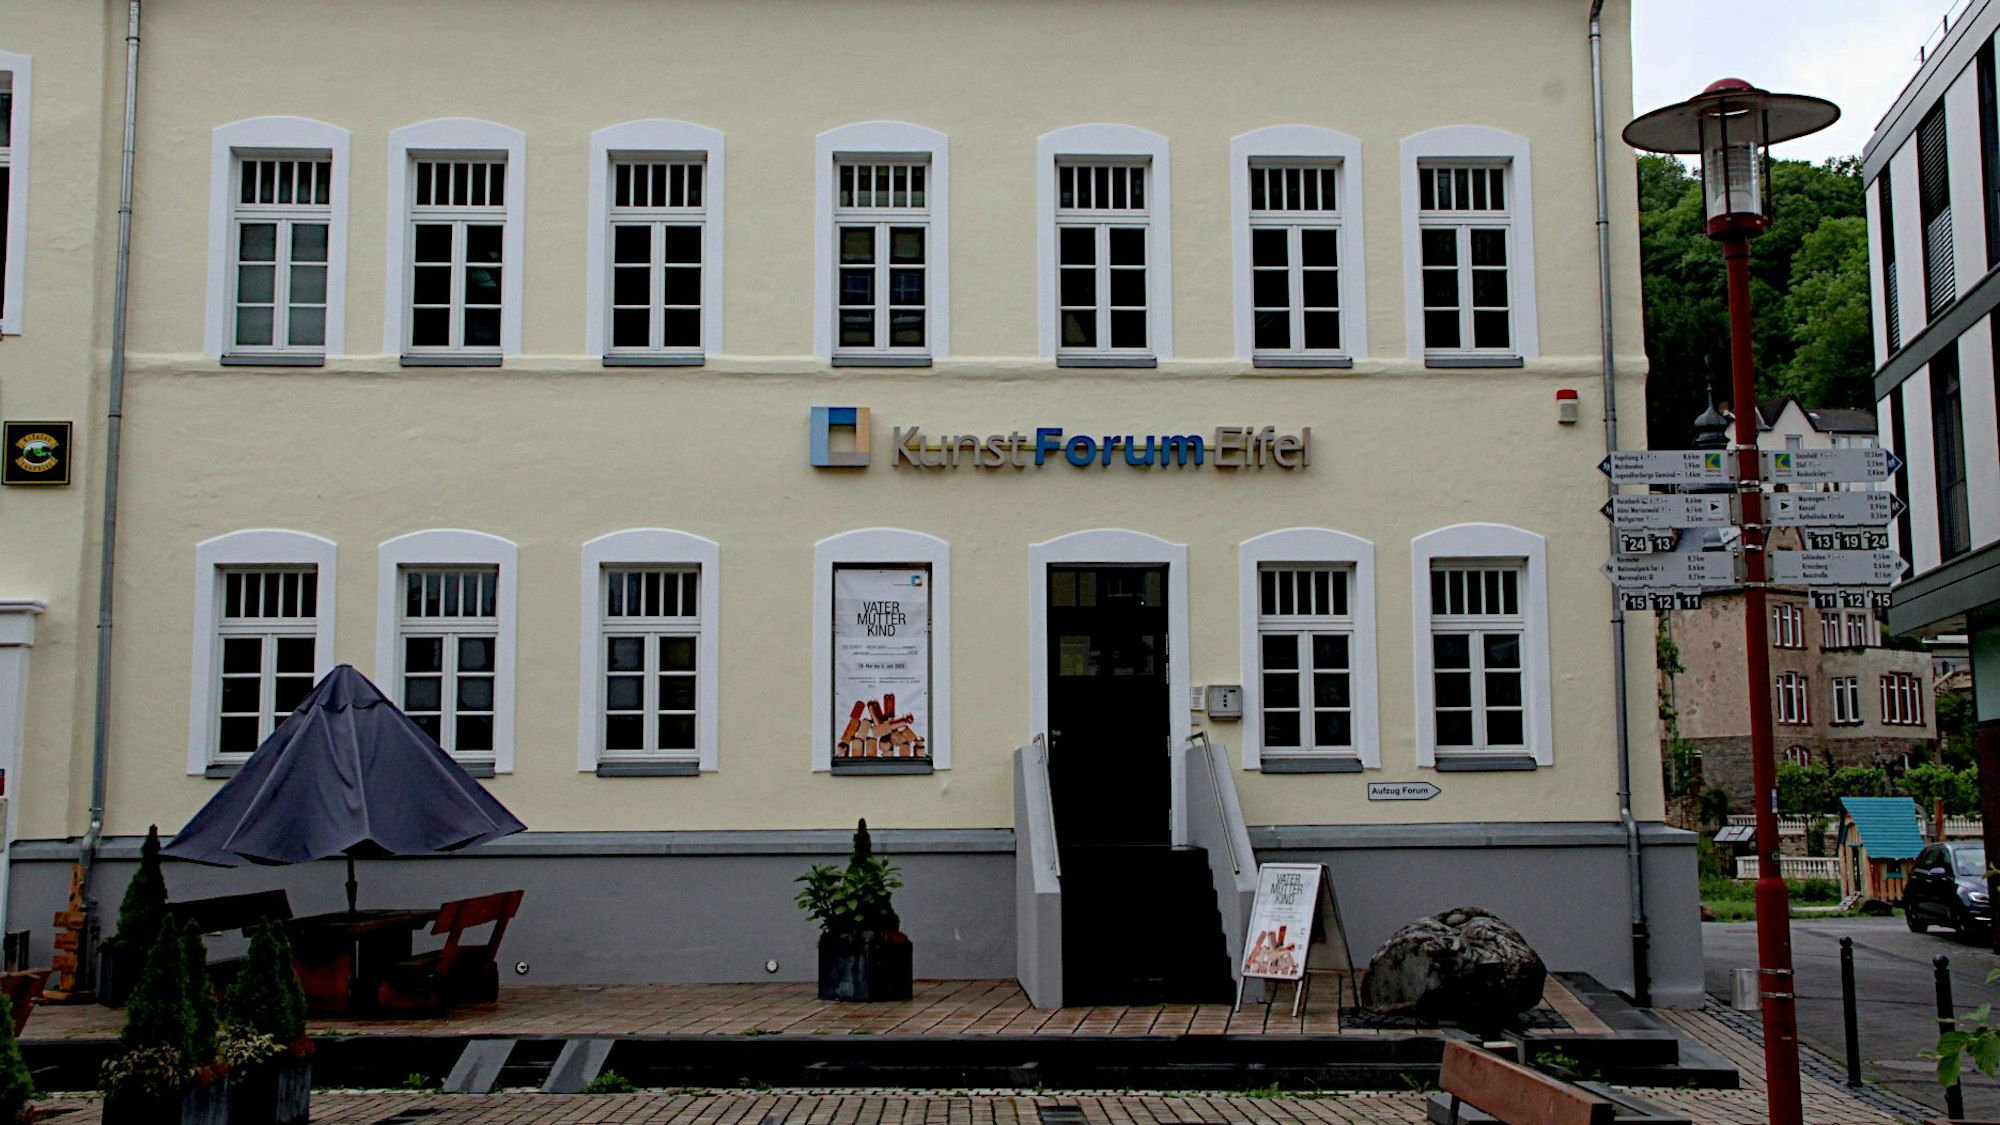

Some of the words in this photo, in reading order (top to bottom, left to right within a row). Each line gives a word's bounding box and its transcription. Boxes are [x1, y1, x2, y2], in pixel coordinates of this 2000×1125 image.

[1629, 538, 1645, 551] 24
[1656, 538, 1671, 550] 13
[1816, 536, 1831, 548] 13
[1844, 536, 1858, 548] 19
[1871, 535, 1887, 547] 24
[1630, 597, 1645, 609] 15
[1657, 596, 1672, 609] 12
[1684, 596, 1699, 608] 11
[1820, 595, 1833, 607] 11
[1848, 595, 1862, 607] 12
[1876, 594, 1891, 607] 15
[863, 601, 900, 614] VATER
[857, 612, 906, 625] MUTTER
[867, 624, 896, 636] KIND
[1372, 787, 1400, 796] Aufzug
[1276, 874, 1301, 885] VATER
[1270, 884, 1303, 895] MUTTER
[1275, 894, 1295, 905] KIND
